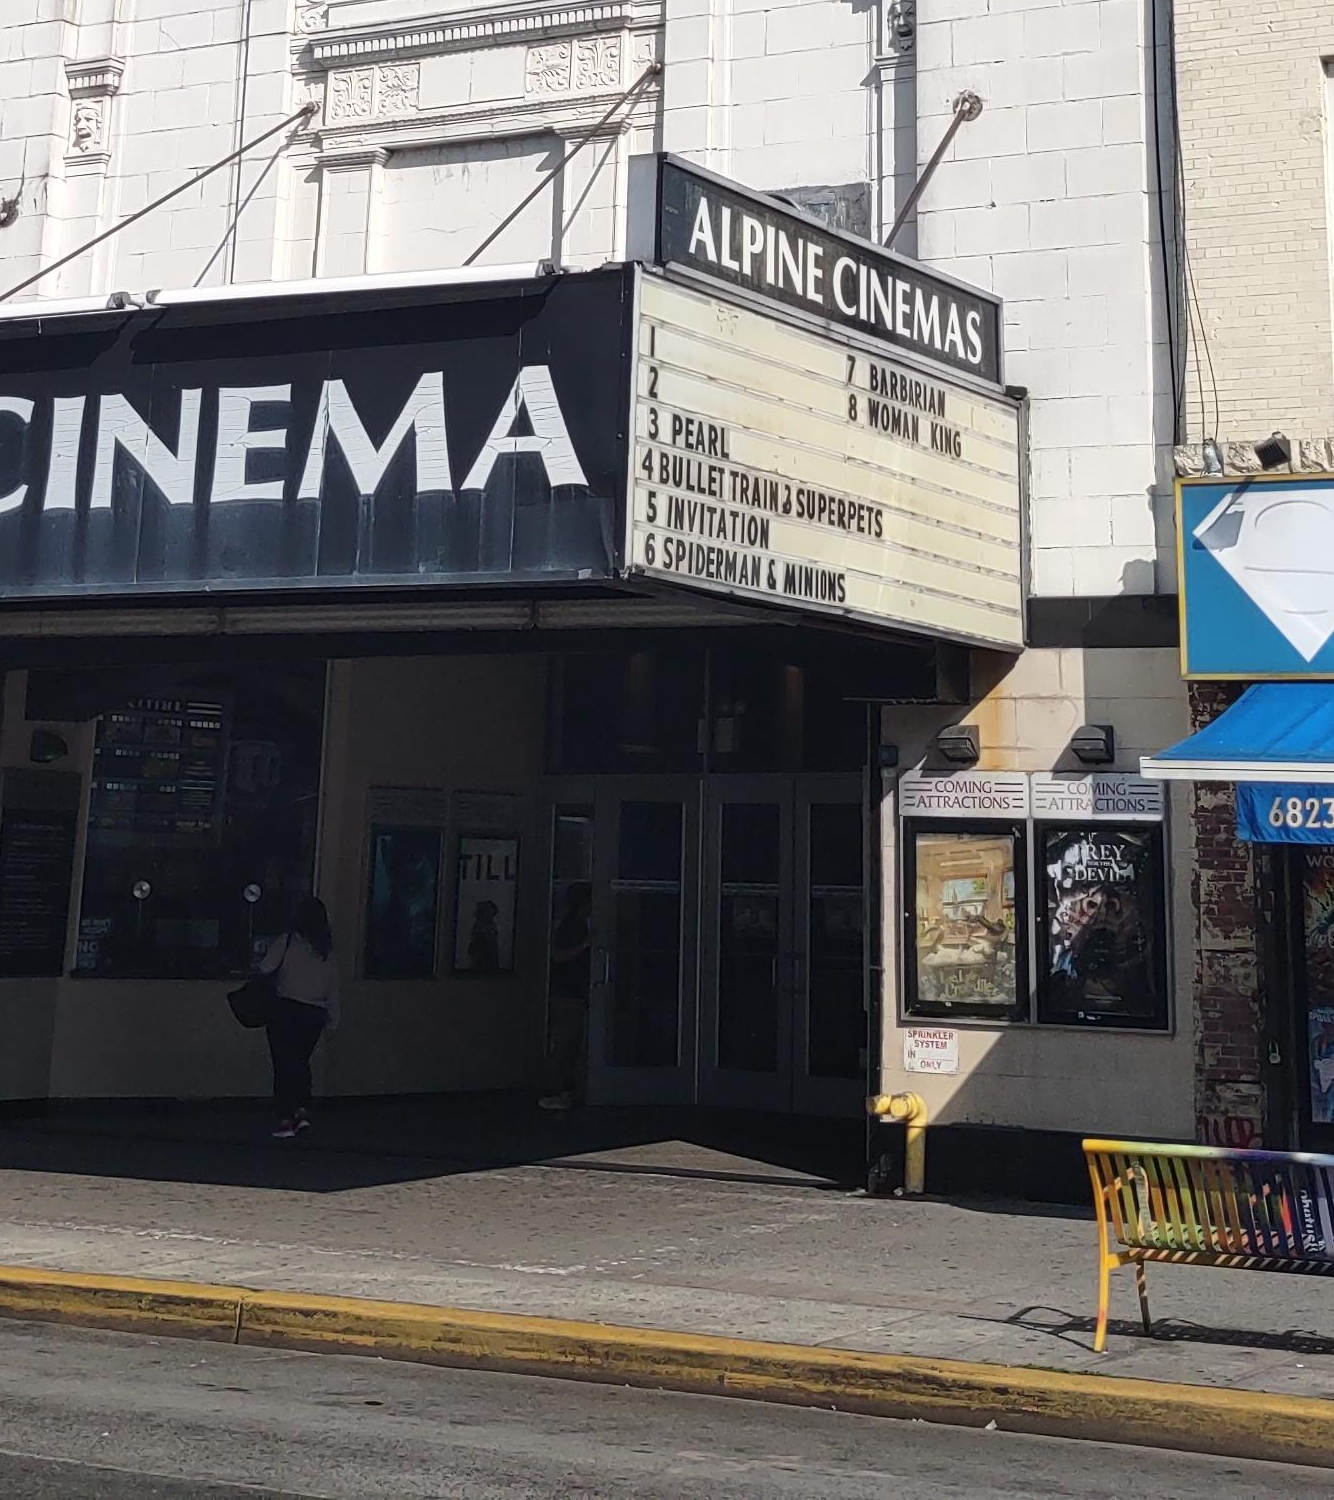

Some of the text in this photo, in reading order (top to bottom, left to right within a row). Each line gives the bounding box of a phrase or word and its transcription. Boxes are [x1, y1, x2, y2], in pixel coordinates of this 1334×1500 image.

[689, 196, 983, 365] ALPINE CINEMAS
[649, 325, 656, 358] 1
[648, 367, 659, 399] 2
[846, 355, 946, 418] 7 BARBARIAN
[648, 407, 730, 459] 3 PEARL
[848, 395, 962, 458] 8 WOMAN KING
[641, 448, 653, 481] 4
[660, 452, 725, 501] BULLET
[730, 469, 779, 512] TRAIN
[796, 488, 883, 538] SUPERPETS
[646, 490, 770, 550] 5 INVITATION
[644, 532, 846, 603] 6 SPIDERMAN & MINIONS
[934, 780, 993, 794] COMING
[1066, 781, 1127, 797] COMING
[916, 795, 1011, 810] ATTRACTIONS
[1048, 798, 1146, 812] ATTRACTIONS
[458, 853, 516, 881] TILL
[907, 1030, 954, 1041] SPRINKLER
[914, 1039, 948, 1050] SYSTEM
[907, 1049, 916, 1059] IN
[920, 1060, 942, 1071] ONLY
